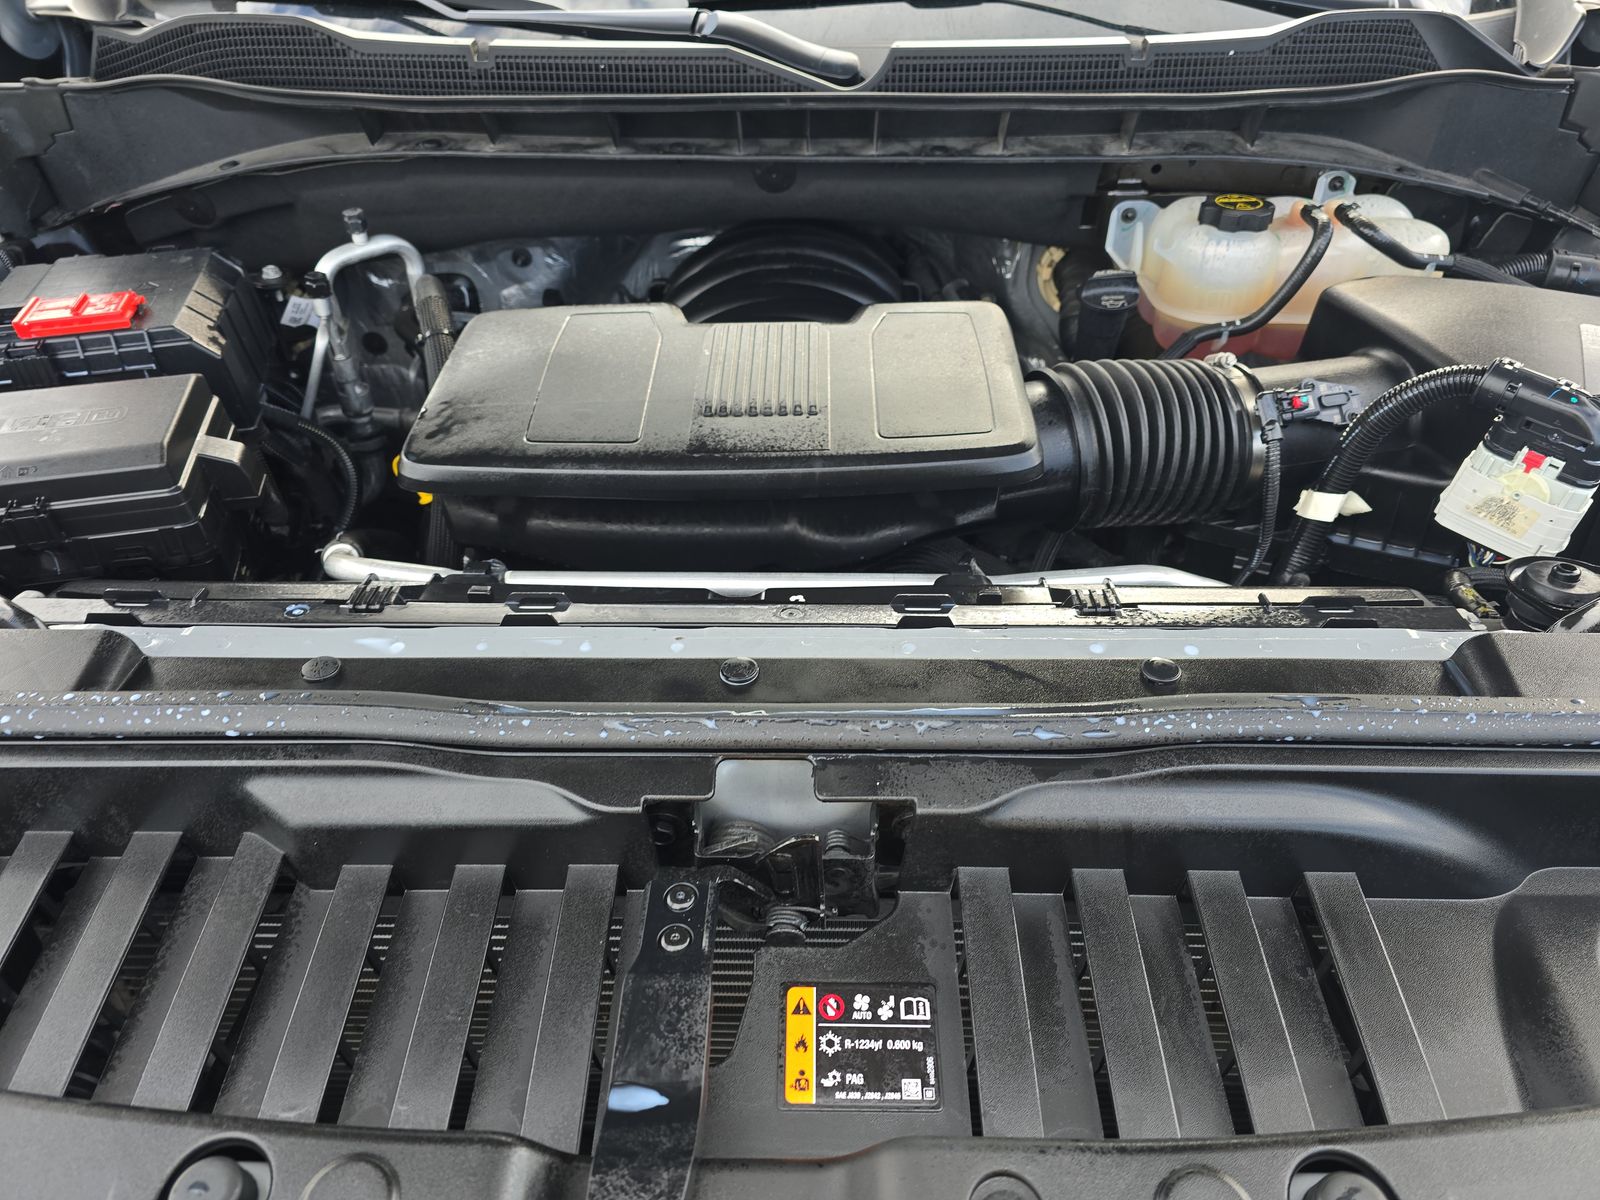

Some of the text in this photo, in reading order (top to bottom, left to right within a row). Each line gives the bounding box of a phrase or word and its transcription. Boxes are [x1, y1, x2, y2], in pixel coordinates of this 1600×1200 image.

[852, 1011, 872, 1020] AUTO
[844, 1039, 924, 1052] R-1234yf 0.600 kg
[846, 1073, 864, 1085] PAG
